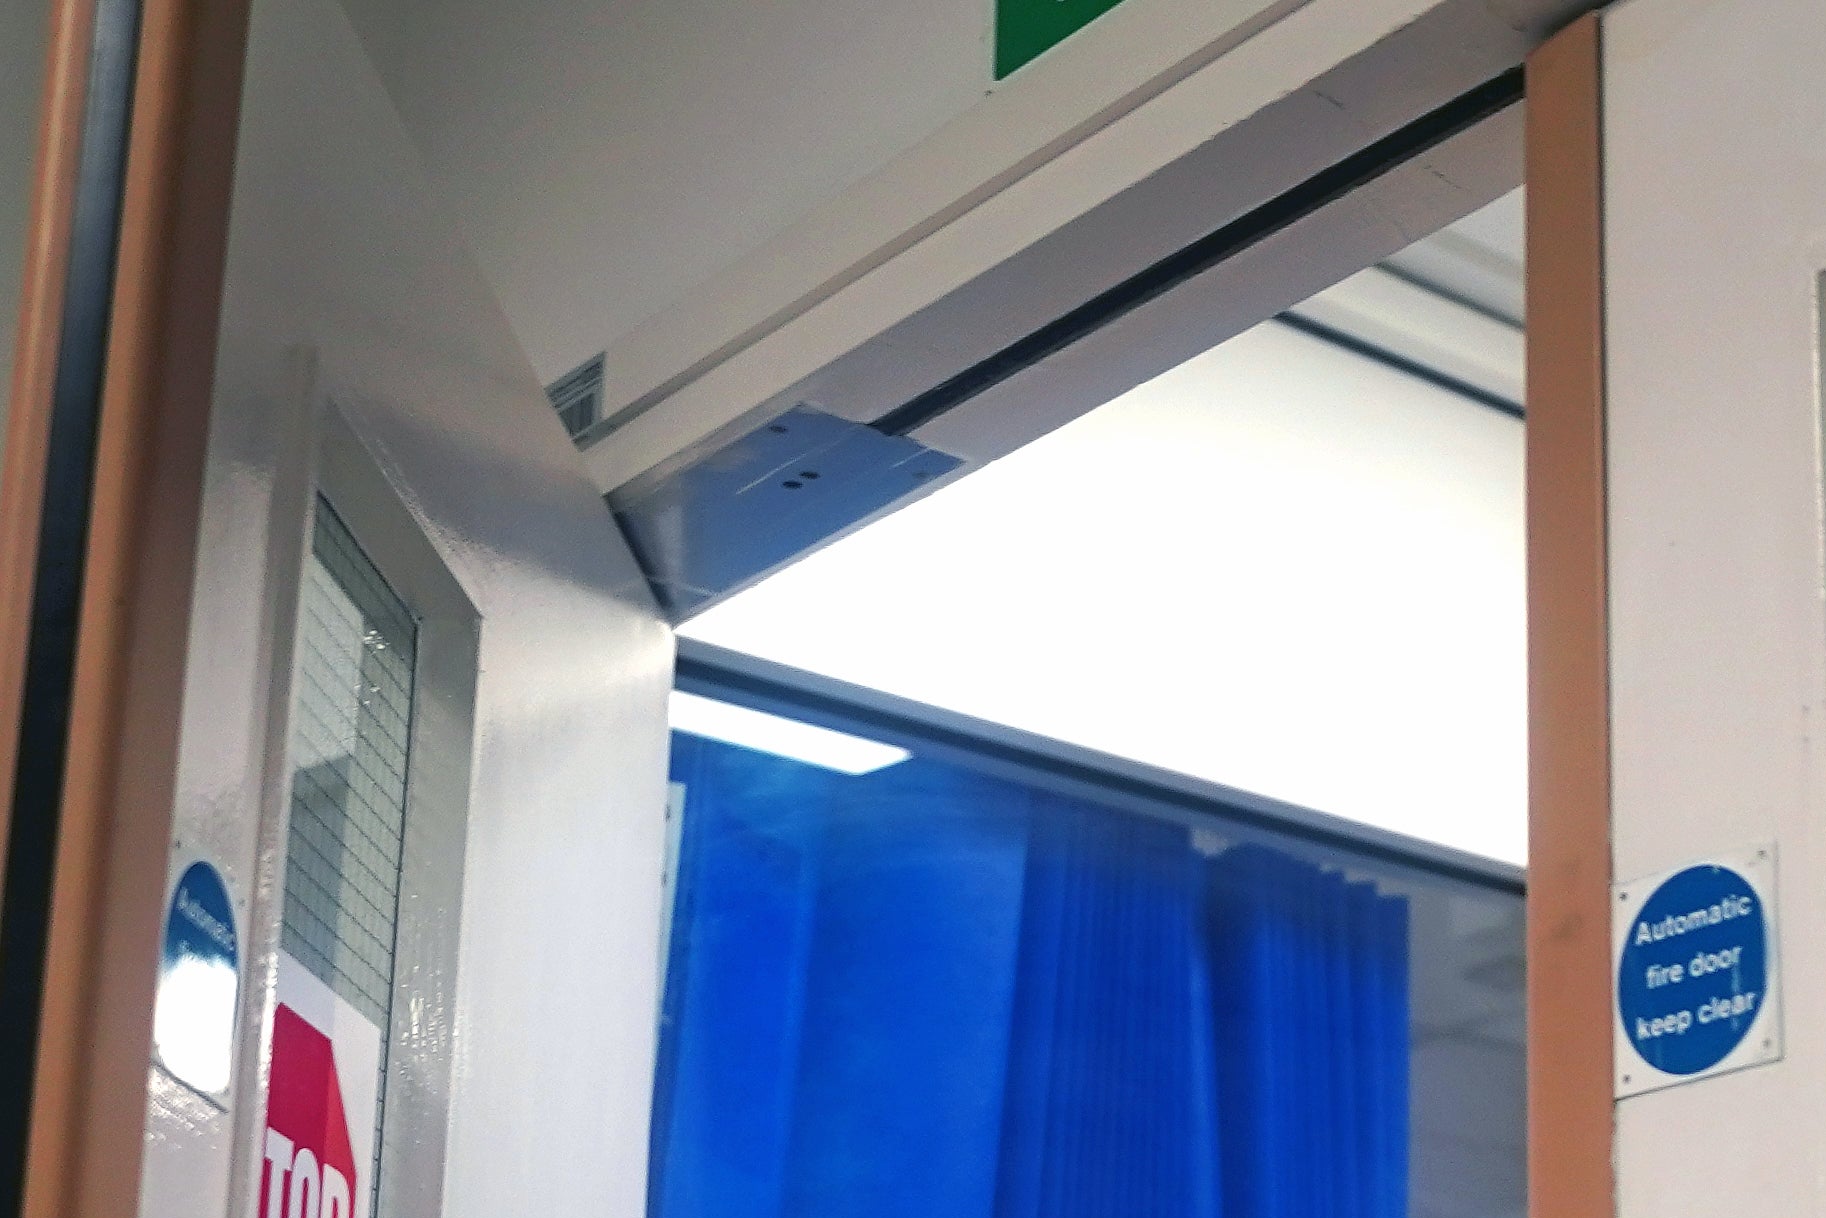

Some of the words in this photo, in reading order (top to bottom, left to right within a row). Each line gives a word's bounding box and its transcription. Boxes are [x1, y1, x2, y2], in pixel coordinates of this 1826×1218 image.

[1634, 894, 1753, 945] Automatic
[1646, 963, 1684, 989] fire
[1689, 946, 1742, 977] door
[1635, 1009, 1693, 1041] keep
[1697, 992, 1756, 1024] clear
